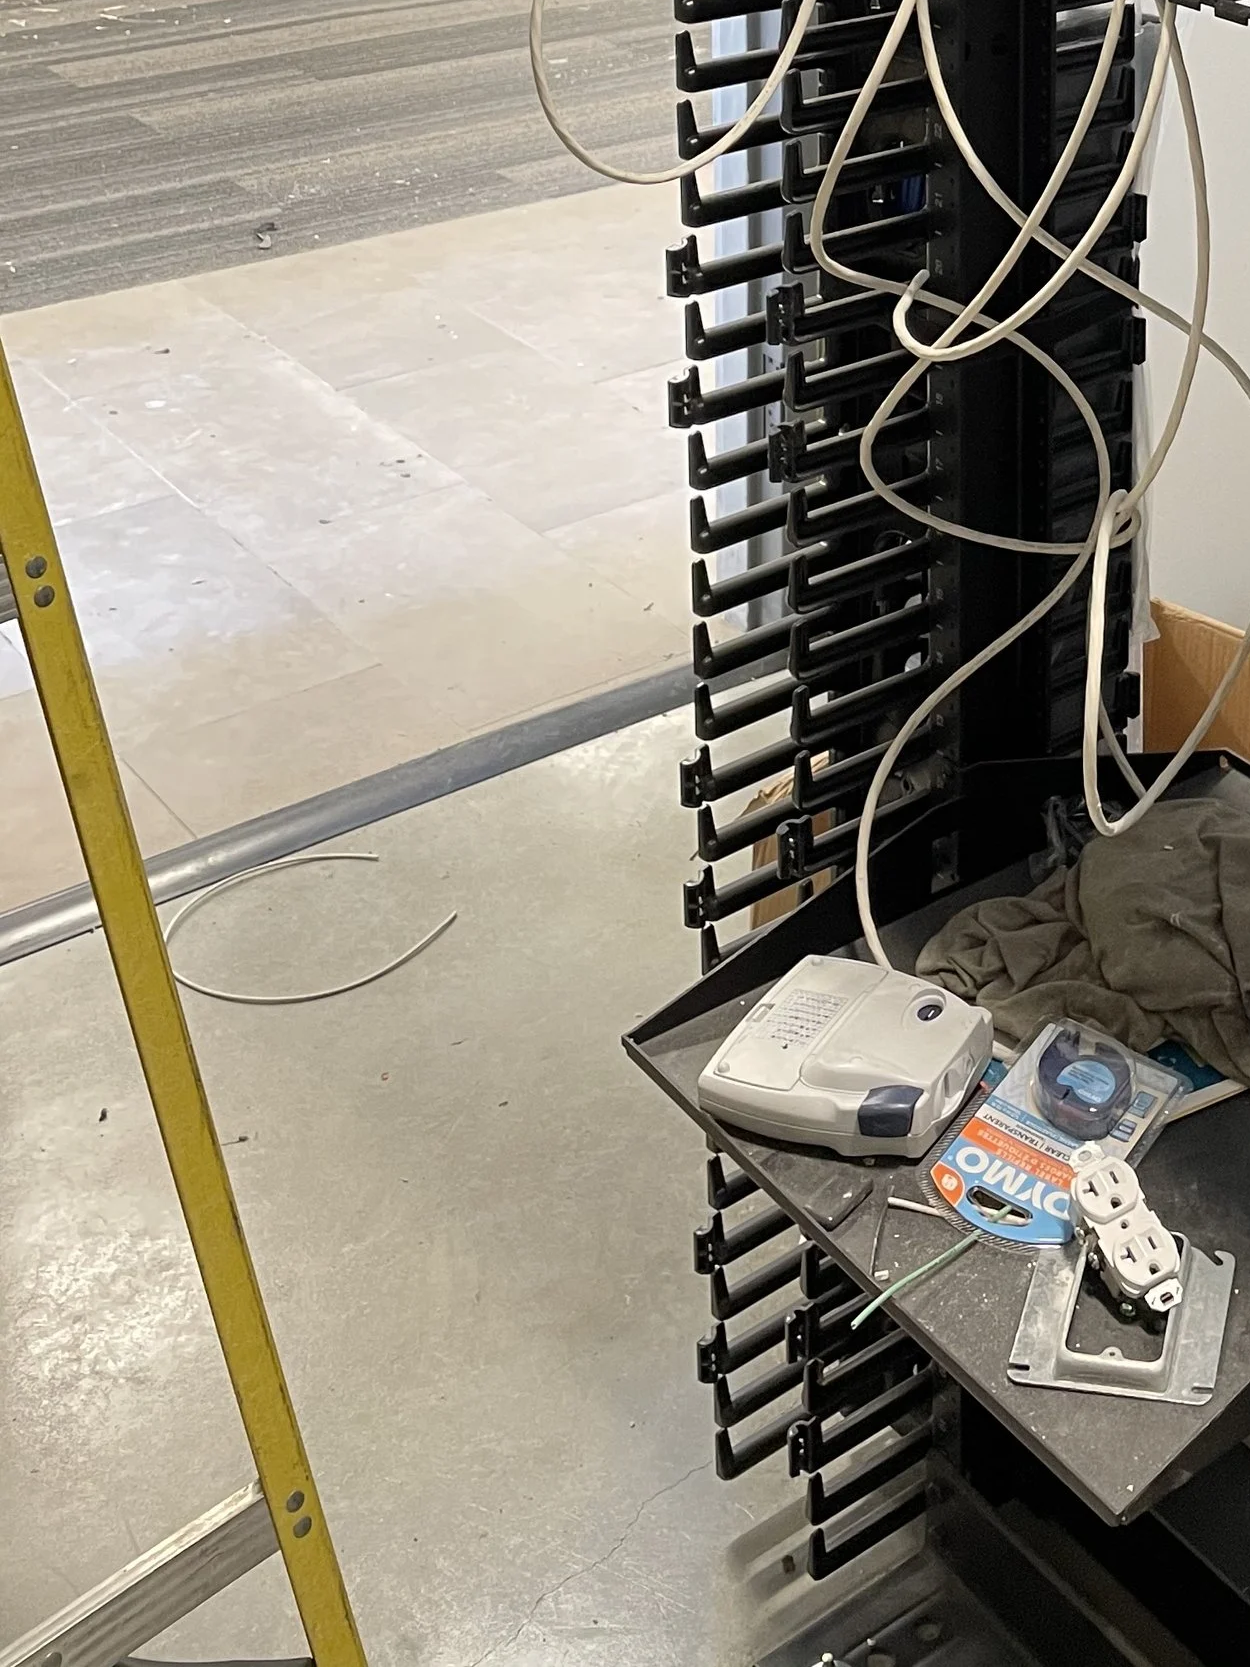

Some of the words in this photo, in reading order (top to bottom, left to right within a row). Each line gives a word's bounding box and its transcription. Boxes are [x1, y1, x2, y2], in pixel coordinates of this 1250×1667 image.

[983, 1113, 1043, 1148] TRANSPARENT
[1047, 1146, 1070, 1162] CLEAR
[955, 1146, 1071, 1221] DYMO
[1034, 1167, 1065, 1187] LABEL
